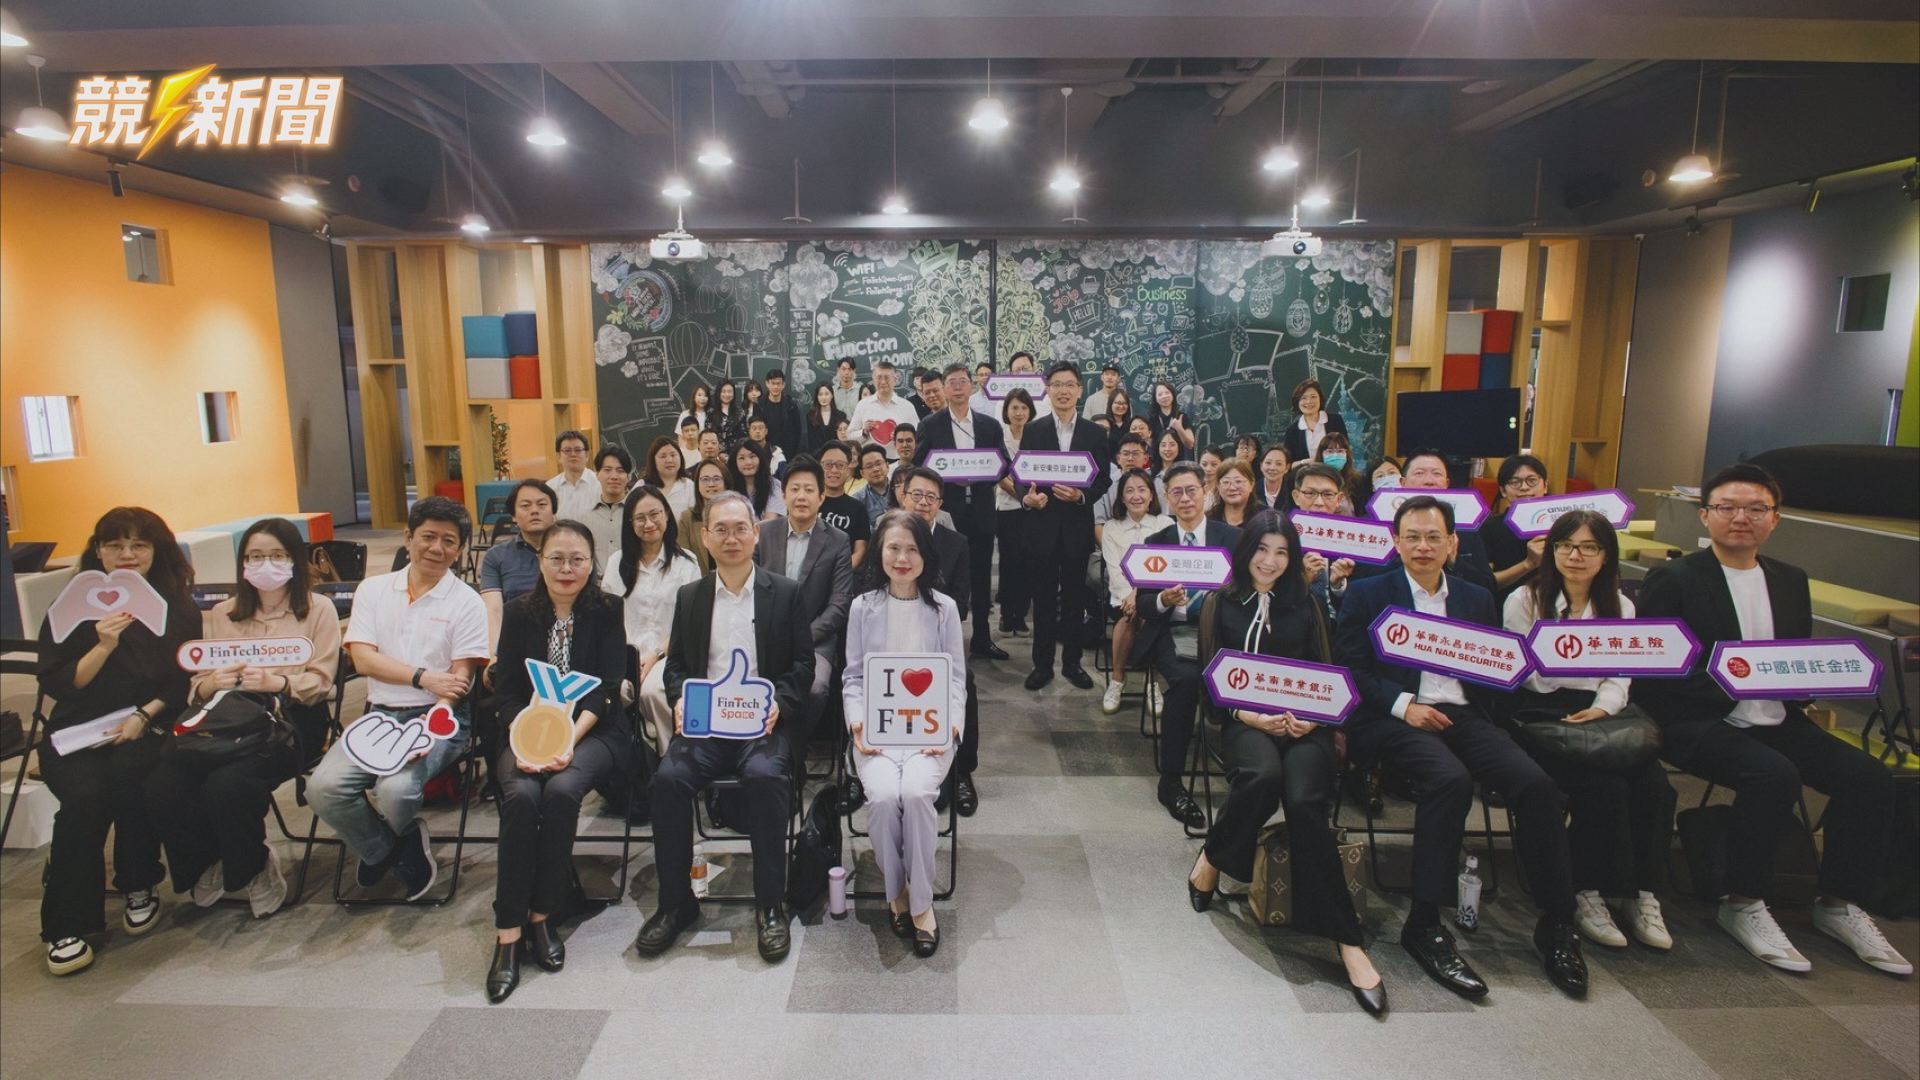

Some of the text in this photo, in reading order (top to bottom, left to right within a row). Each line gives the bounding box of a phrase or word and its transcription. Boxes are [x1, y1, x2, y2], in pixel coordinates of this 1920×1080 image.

[846, 262, 875, 277] WIFI
[1137, 285, 1187, 301] Business
[822, 332, 898, 360] Function
[1586, 636, 1665, 649] 華南產險
[209, 644, 301, 659] FinTechSpace
[1414, 642, 1513, 672] HUA NAN SECURITIES
[1756, 659, 1863, 675] 中國信託金控
[883, 668, 895, 697] I
[1255, 672, 1334, 695] 華南商業銀行
[717, 696, 760, 709] FinTech
[721, 708, 755, 720] Space
[877, 708, 939, 735] FTS
